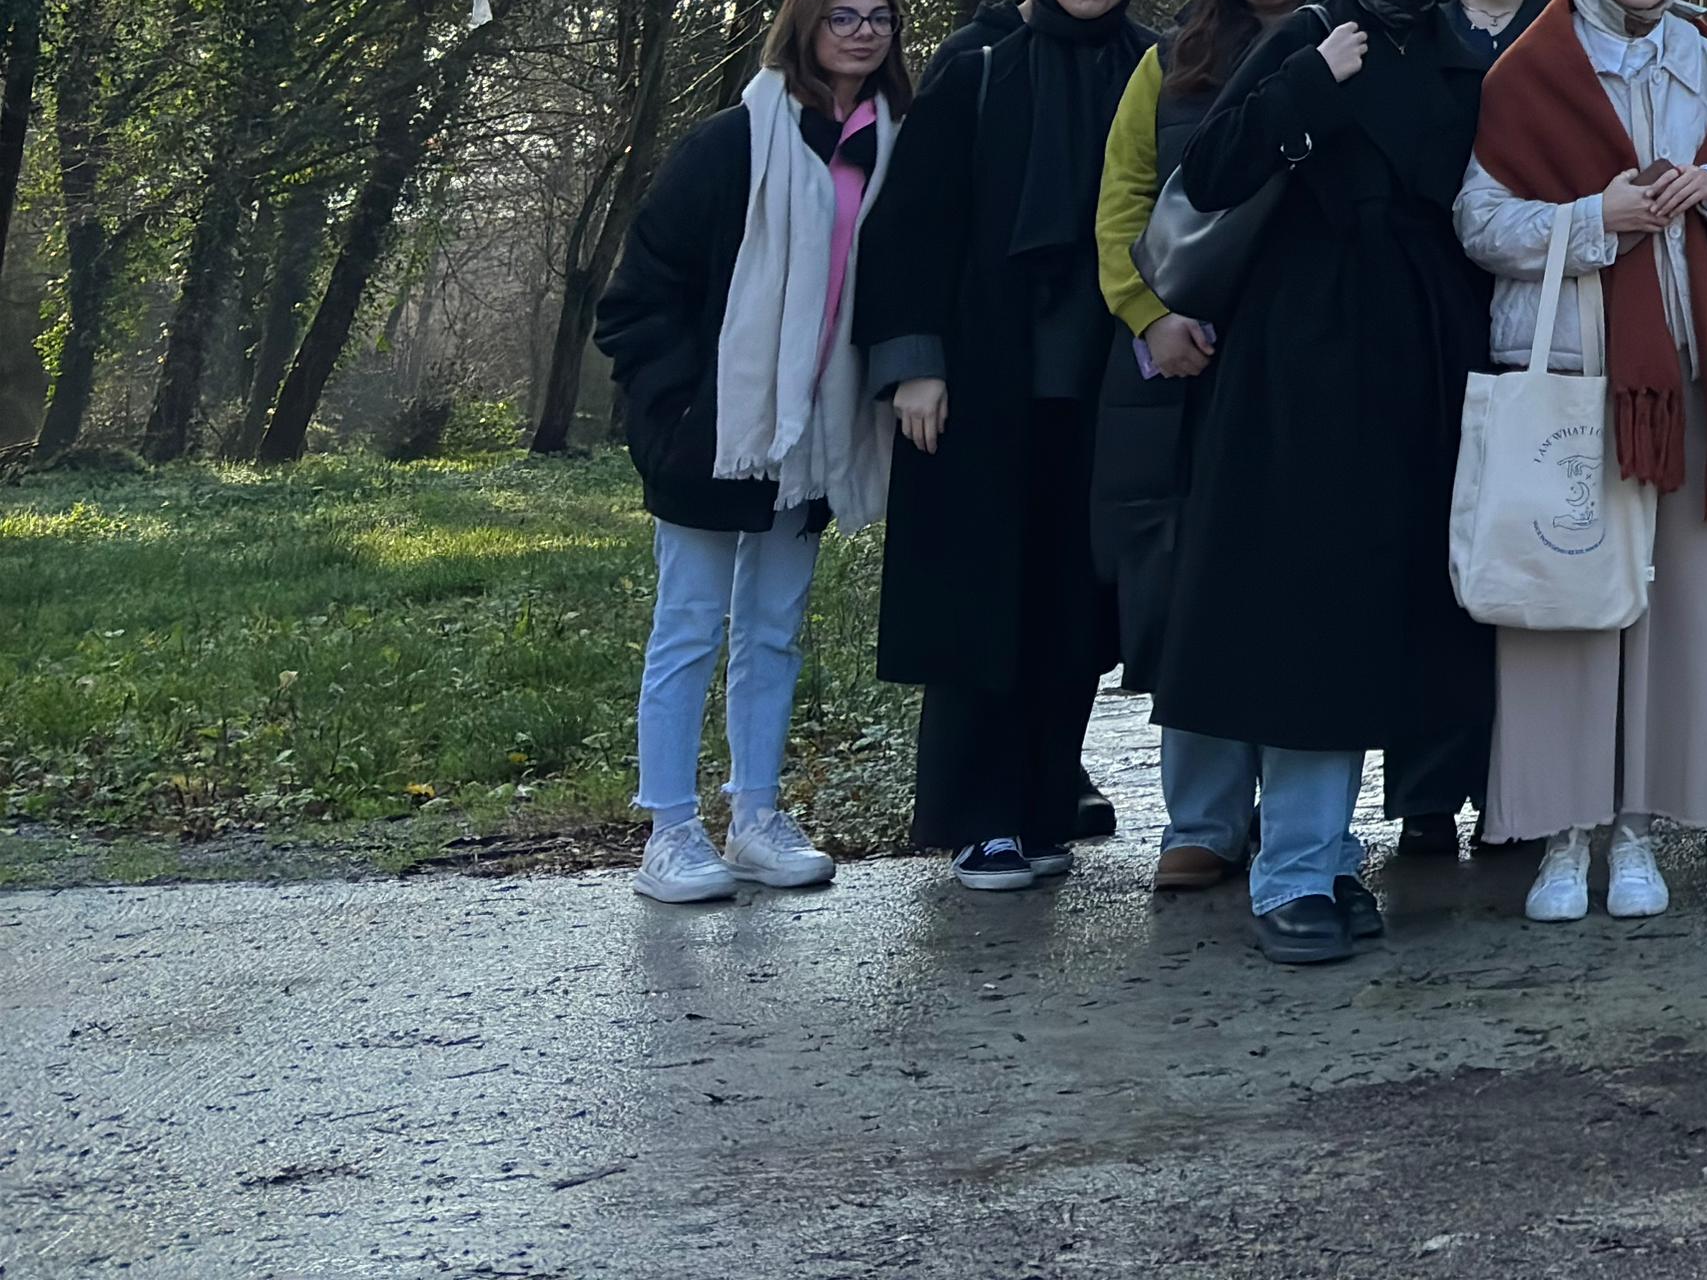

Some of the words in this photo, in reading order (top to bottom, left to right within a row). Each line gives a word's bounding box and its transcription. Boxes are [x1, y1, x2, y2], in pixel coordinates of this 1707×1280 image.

[1539, 439, 1552, 456] AM
[1552, 425, 1588, 440] WHAT
[1589, 426, 1594, 436] I
